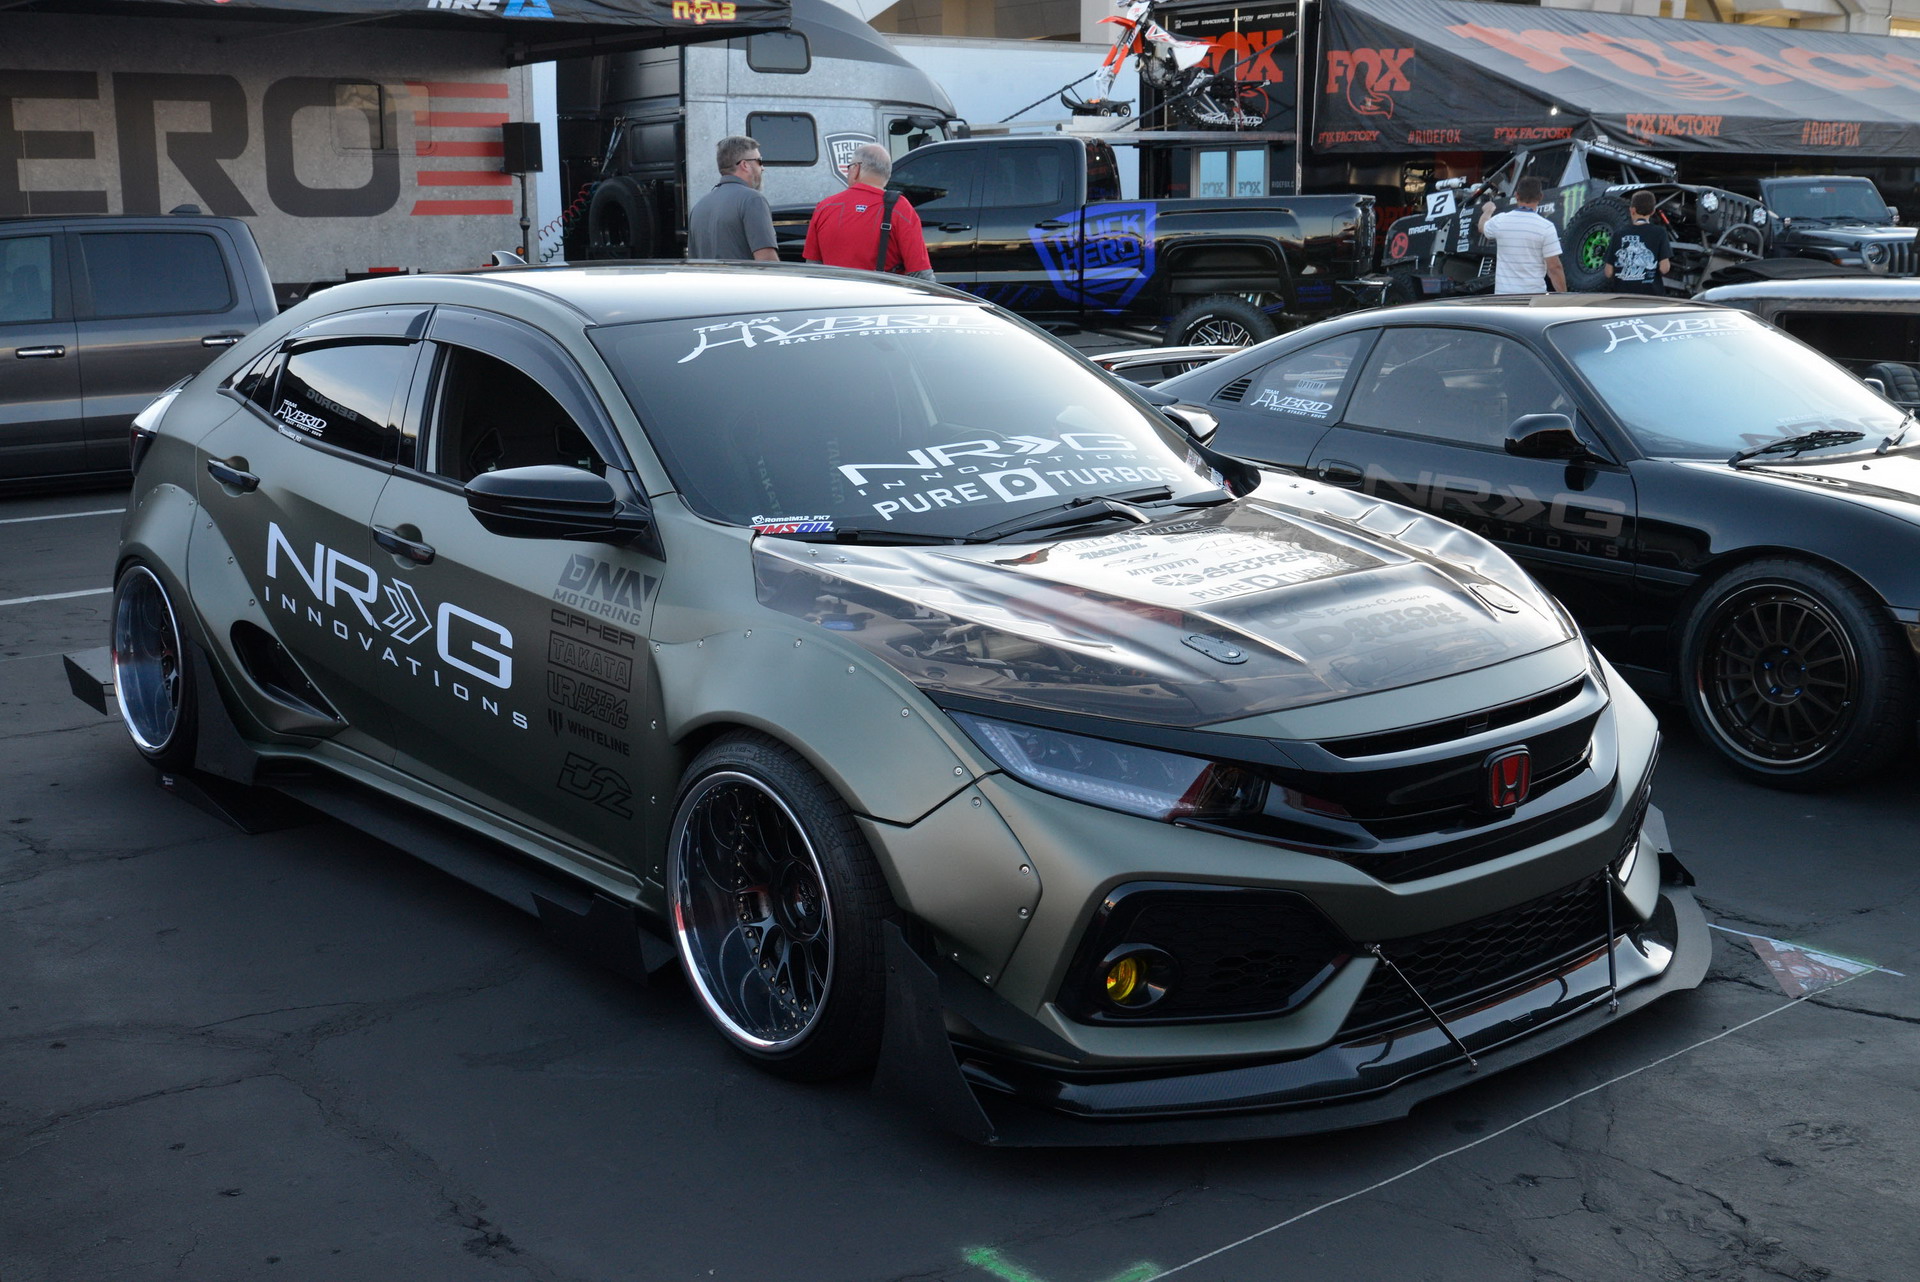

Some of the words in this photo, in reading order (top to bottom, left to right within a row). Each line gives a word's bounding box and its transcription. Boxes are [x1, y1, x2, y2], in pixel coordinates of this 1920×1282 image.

[1326, 48, 1415, 105] FOX
[1319, 131, 1335, 143] FOX
[1336, 130, 1380, 142] FACTORY
[1407, 129, 1461, 145] #RIDEFOX
[1494, 127, 1518, 140] FOX
[1518, 127, 1574, 139] FACTORY
[1626, 113, 1656, 138] FOX
[1658, 114, 1723, 136] FACTORY
[1801, 120, 1861, 146] #RIDEFOX
[0, 67, 401, 217] ERO
[834, 142, 864, 153] TRU
[1202, 181, 1224, 194] FOX
[1238, 180, 1261, 194] FOX
[1431, 193, 1449, 215] 2
[1047, 213, 1141, 254] TRUCK
[1408, 223, 1438, 236] MAGPUL
[1061, 236, 1140, 274] HERO
[693, 315, 780, 334] TEAM
[779, 333, 836, 346] RACE
[858, 327, 934, 337] STREET
[1602, 318, 1645, 330] TEAM
[1661, 334, 1693, 343] RACE
[858, 453, 1160, 497] INNOVATIONS
[872, 482, 989, 521] PURE
[1046, 466, 1183, 487] TURBOS
[749, 521, 835, 535] AMSOIL
[1454, 518, 1620, 558] VATIONS
[1203, 548, 1306, 574] ACTION
[1205, 552, 1320, 578] CLUTCH
[1190, 582, 1253, 600] PURE
[266, 521, 513, 690] NRG
[553, 588, 642, 626] MOTORING
[551, 608, 636, 650] CIPHER
[265, 586, 529, 730] INNOVATIONS
[552, 638, 627, 685] TAKATA
[568, 719, 630, 757] WHITELINE
